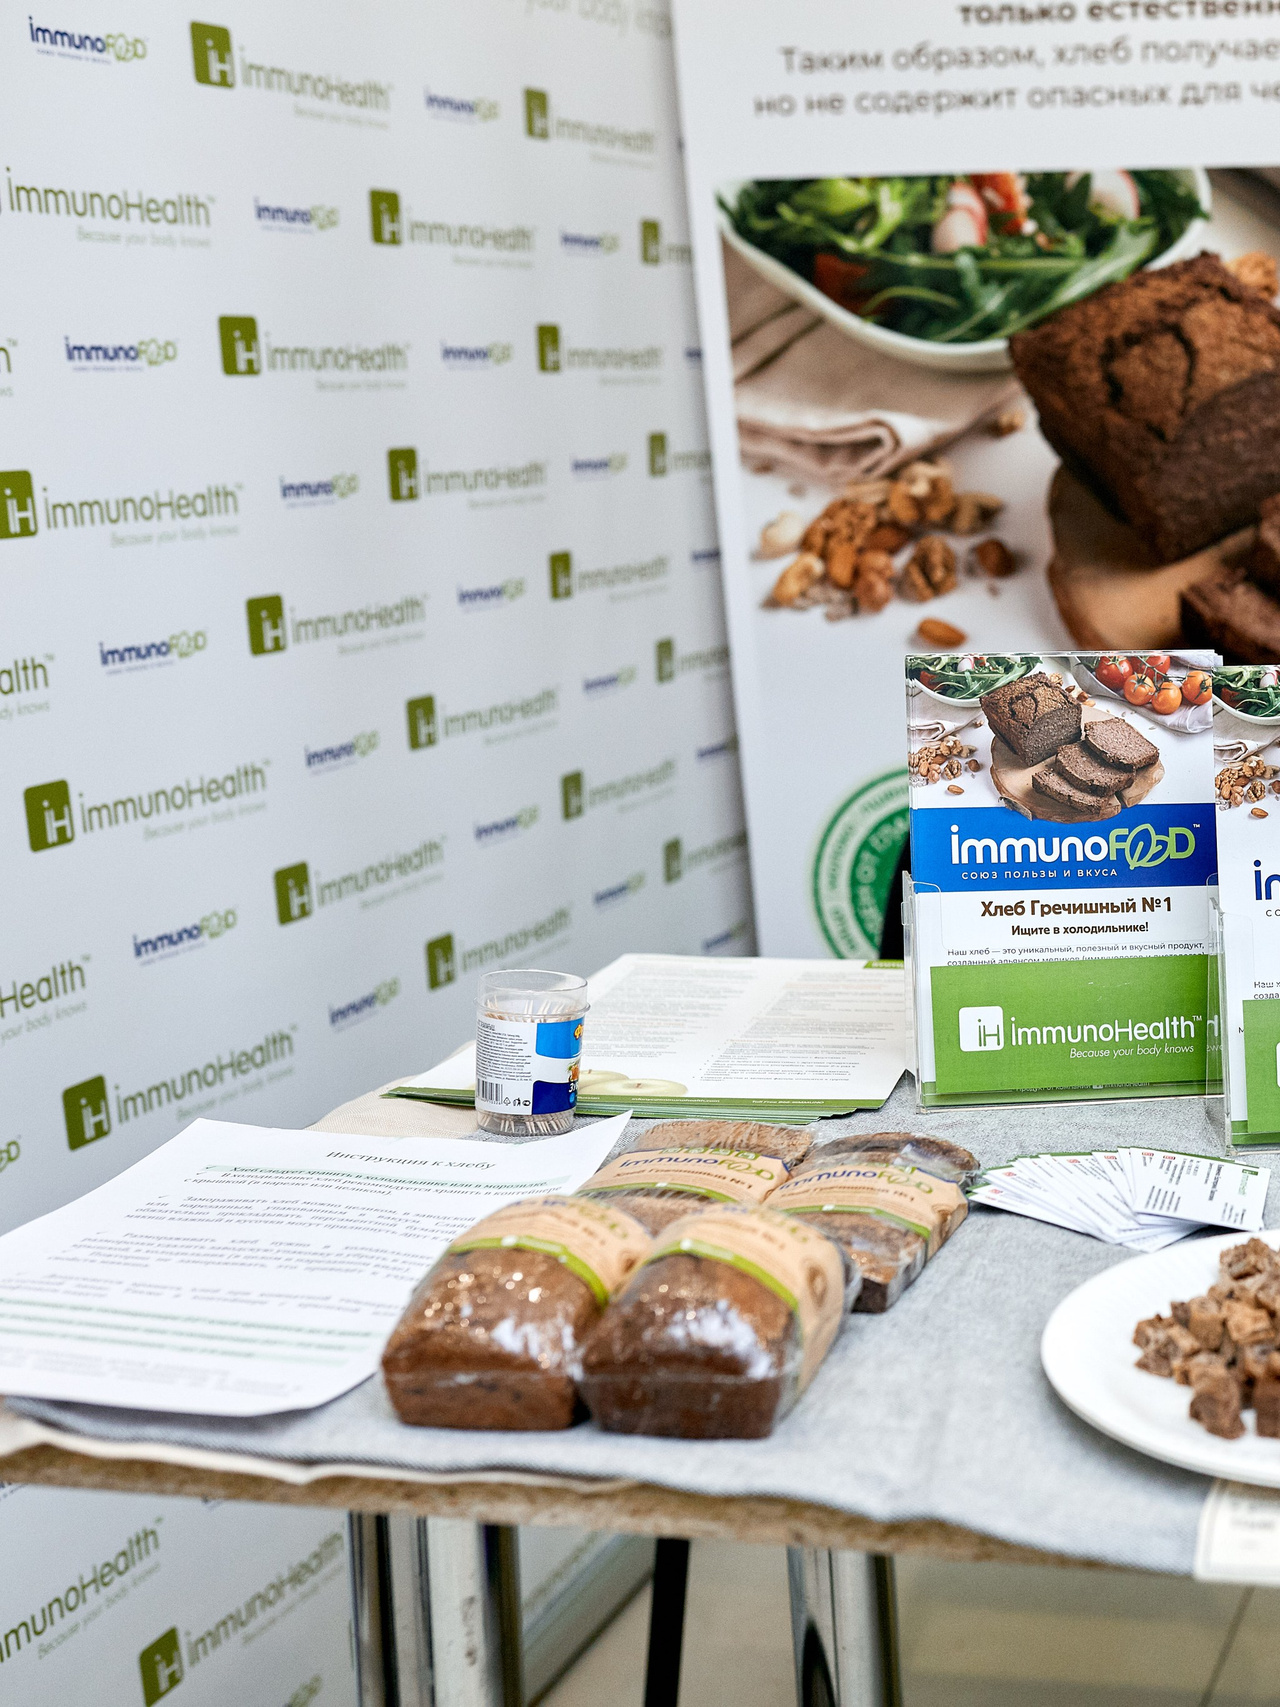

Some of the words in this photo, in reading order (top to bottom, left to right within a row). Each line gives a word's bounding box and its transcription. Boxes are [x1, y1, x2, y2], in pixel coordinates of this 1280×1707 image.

[959, 3, 1076, 25] только
[781, 46, 883, 74] Таким
[892, 40, 1045, 75] образом,
[1053, 35, 1131, 66] хлеб
[754, 94, 797, 117] но
[805, 92, 844, 116] не
[854, 87, 1018, 119] содержит
[1027, 84, 1172, 111] опасных
[1181, 81, 1242, 107] для
[961, 871, 998, 880] СОЮЗ
[1004, 869, 1057, 879] ПОЛЬЗЫ
[1063, 869, 1071, 878] И
[1077, 868, 1118, 878] ВКУСА
[980, 899, 1026, 917] Хлеб
[1030, 897, 1137, 918] Гречишный
[1011, 924, 1050, 937] Ищите
[1053, 926, 1060, 935] в
[1063, 922, 1149, 935] холодильнике!
[947, 948, 968, 956] Наш
[969, 947, 990, 956] хлеб
[1002, 947, 1017, 956] это
[1018, 945, 1075, 957] уникальный,
[1076, 943, 1120, 954] полезный
[1129, 943, 1166, 953] вкусный
[1168, 941, 1205, 953] продукт,
[1069, 1047, 1111, 1059] Because
[1112, 1048, 1134, 1060] your
[1136, 1044, 1162, 1057] body
[1164, 1043, 1195, 1055] knows
[326, 1151, 428, 1166] Инструкция
[447, 1160, 497, 1170] хлебу
